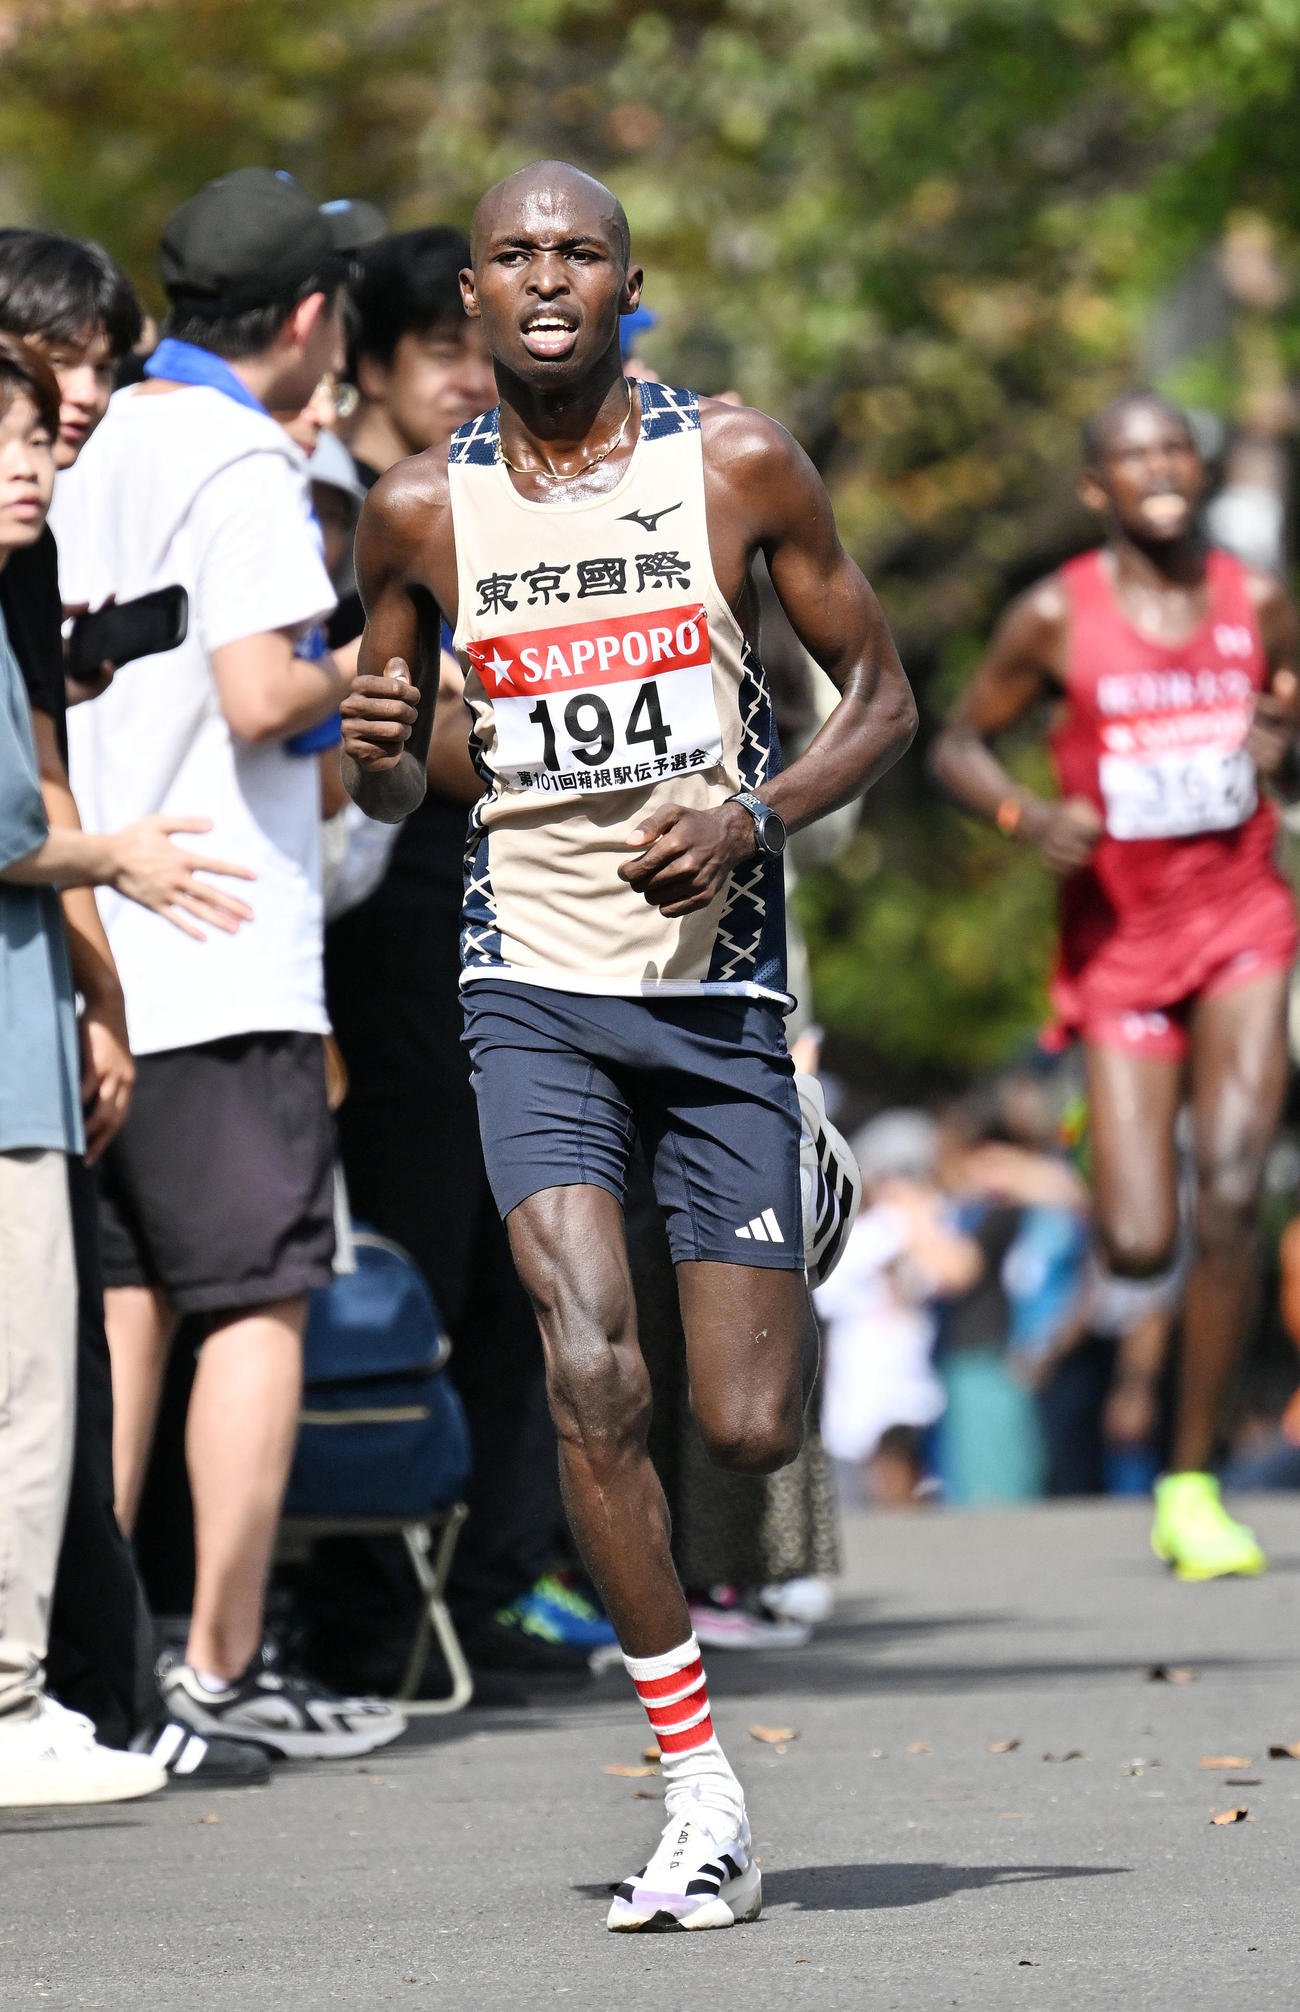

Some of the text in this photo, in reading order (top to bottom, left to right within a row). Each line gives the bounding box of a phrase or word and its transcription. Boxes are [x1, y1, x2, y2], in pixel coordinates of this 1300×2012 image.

[475, 550, 692, 616] 東京國際
[519, 620, 702, 684] SAPPORO
[528, 680, 673, 772] 194
[517, 748, 706, 791] 第101回箱根駅伝予選会
